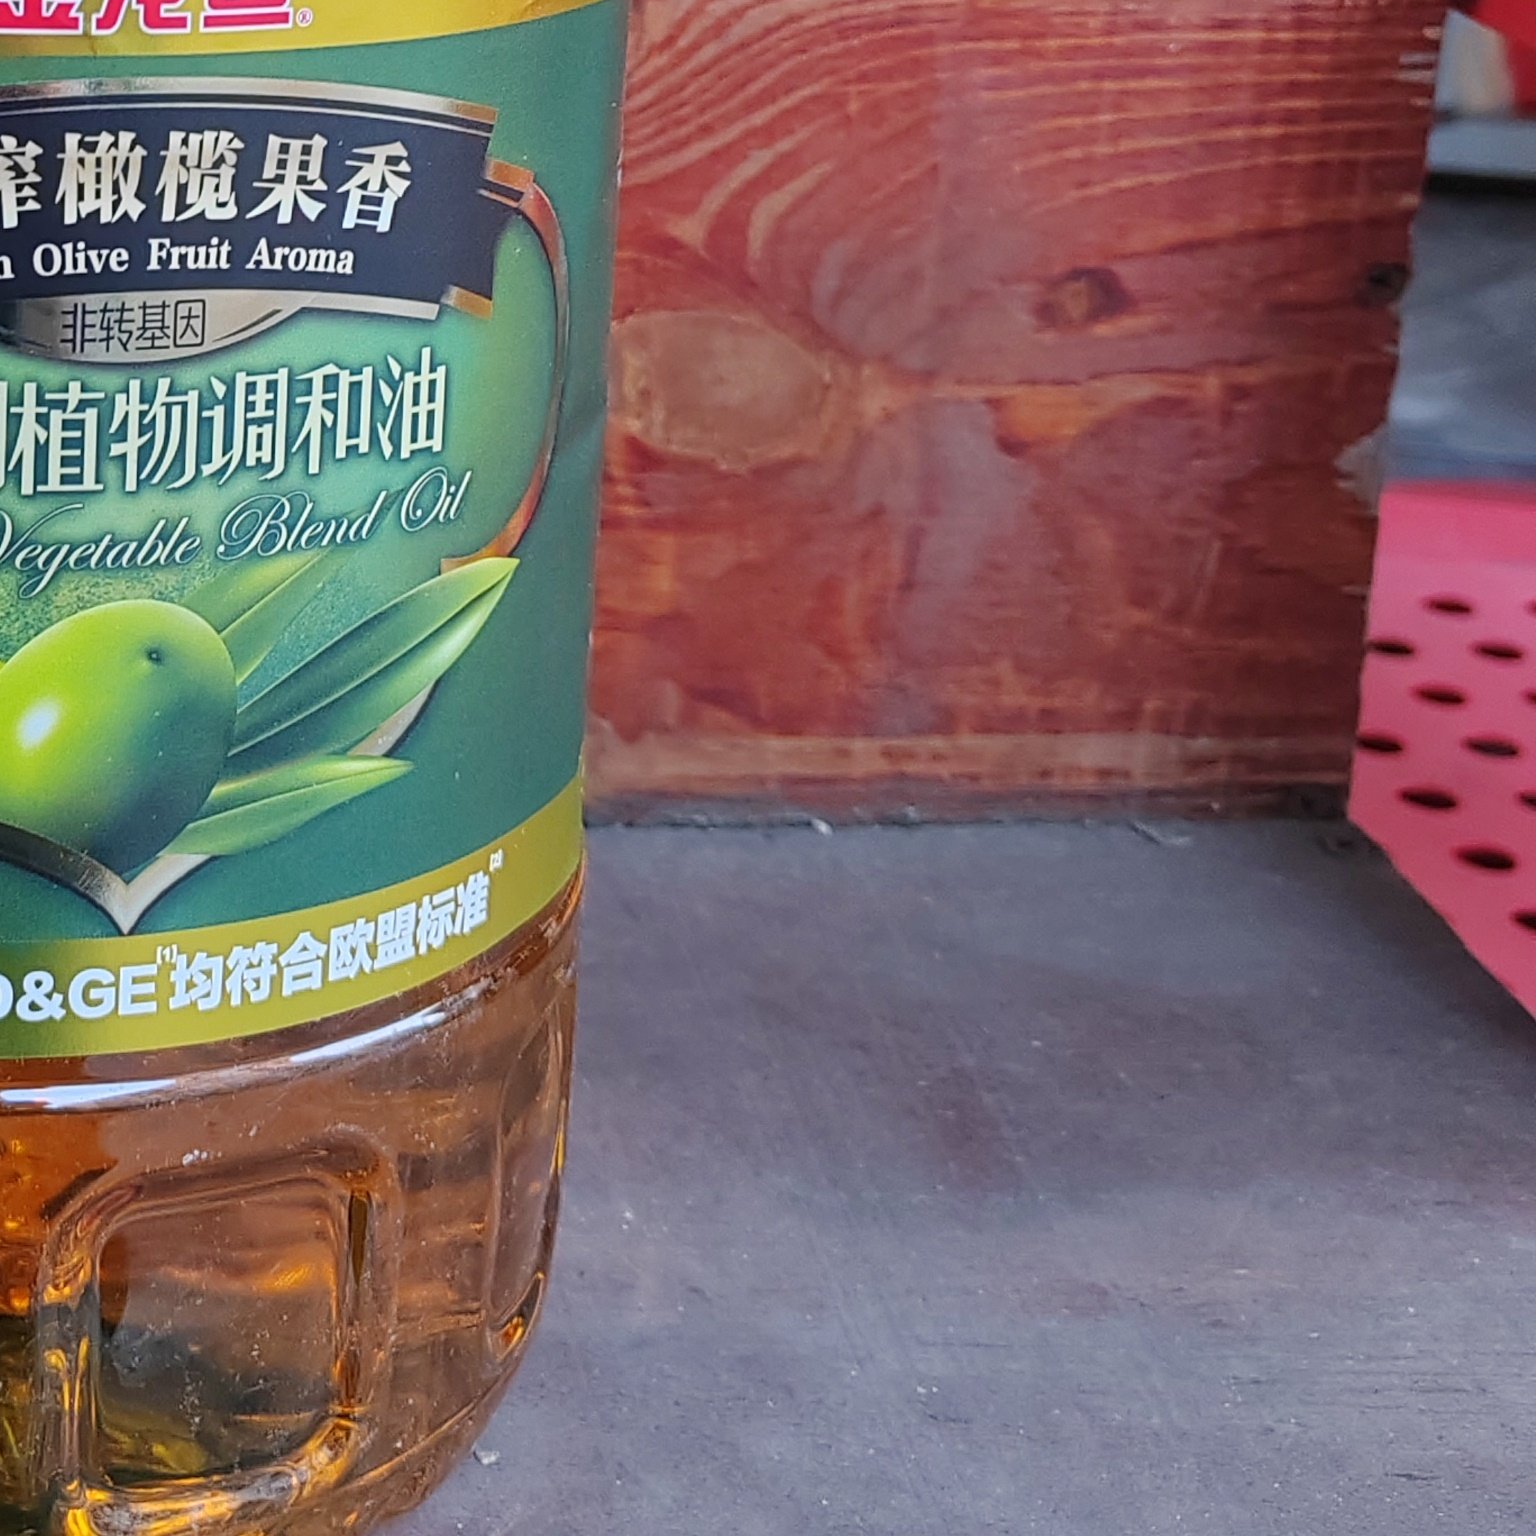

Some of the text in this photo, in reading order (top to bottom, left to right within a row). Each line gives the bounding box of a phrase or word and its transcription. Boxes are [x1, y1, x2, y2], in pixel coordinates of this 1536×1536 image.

[32, 242, 130, 277] Olive
[147, 237, 232, 272] Fruit
[245, 237, 355, 275] Aroma
[60, 298, 207, 354] 非转基因
[217, 491, 387, 563] Blend
[400, 466, 474, 533] Oil
